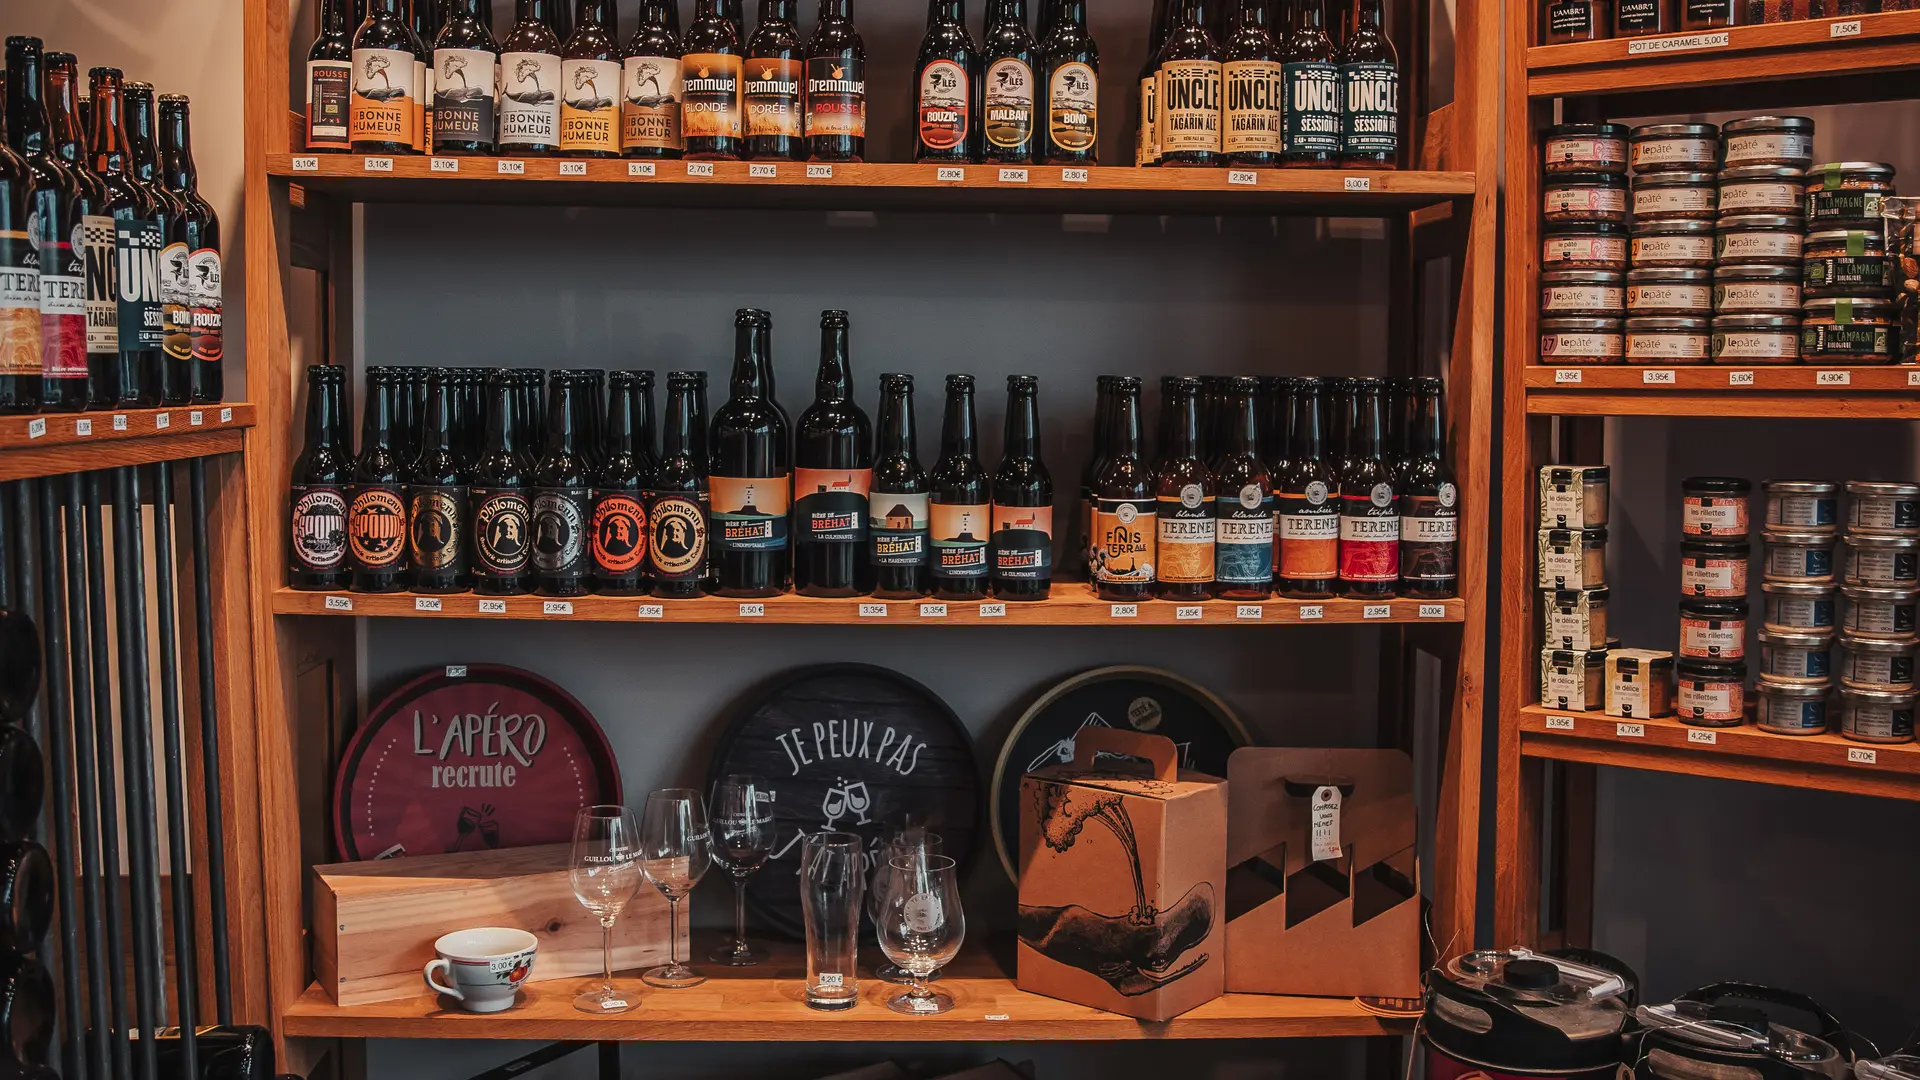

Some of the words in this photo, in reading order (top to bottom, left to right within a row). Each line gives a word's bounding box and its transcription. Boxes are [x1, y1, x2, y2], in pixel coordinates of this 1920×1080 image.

[1630, 42, 1646, 52] POT
[1648, 41, 1660, 50] DE
[1661, 38, 1701, 49] CARAMEL
[313, 69, 348, 79] ROUSSE
[809, 79, 865, 95] Dremmwel
[1167, 79, 1220, 112] UNCLE
[1229, 79, 1280, 112] UNCLE
[686, 102, 728, 113] BLONDE
[750, 102, 786, 115] DORÉE
[815, 102, 858, 114] ROUSSE
[359, 110, 402, 121] BONNE
[438, 110, 480, 121] BONNE
[509, 113, 552, 125] BONNE
[927, 112, 958, 123] ROUZIC
[990, 109, 1028, 123] MALBAN
[1063, 113, 1088, 125] BONO
[353, 121, 401, 133] HUMEUR
[568, 121, 609, 132] BONNE
[630, 117, 672, 128] BONNE
[1170, 118, 1203, 132] TAGARIN
[1231, 118, 1265, 132] TAGARIN
[1301, 119, 1332, 133] SESSION
[1354, 119, 1388, 133] SESSION
[503, 124, 551, 135] HUMEUR
[625, 127, 671, 139] HUMEUR
[563, 131, 609, 142] HUMEUR
[295, 159, 317, 169] 3,10€
[368, 160, 389, 169] 3,10€
[434, 161, 455, 171] 3,10€
[501, 162, 522, 172] 3,10€
[563, 163, 584, 173] 3,10€
[631, 164, 652, 174] 3,10€
[688, 164, 704, 174] 2,70
[751, 166, 767, 176] 2,70
[808, 167, 823, 176] 2,70
[1346, 180, 1360, 189] 3,00
[1731, 373, 1753, 382] 5,60€
[1821, 373, 1844, 382] 4,90€
[296, 494, 346, 514] Philomenn
[352, 493, 401, 514] Philomenn
[480, 500, 530, 523] Philomenn
[596, 500, 645, 524] Philomenn
[651, 502, 701, 525] Philomenn
[1175, 510, 1207, 518] blonde
[1231, 510, 1267, 519] blanche
[1367, 507, 1394, 518] triple
[1106, 526, 1141, 544] FINIS
[419, 600, 440, 609] 3,20€
[482, 601, 504, 611] 2,95€
[546, 603, 567, 612] 2,95€
[981, 605, 1002, 614] 3,35€
[640, 606, 661, 615] 2,95€
[740, 606, 757, 615] 6,50
[863, 606, 884, 615] 3,35€
[923, 606, 944, 615] 3,35€
[414, 701, 547, 767] L'APÉRO
[1691, 732, 1713, 741] 4,25€
[775, 727, 813, 775] JE
[813, 717, 874, 761] PEUX
[875, 726, 927, 775] PAS
[1850, 750, 1874, 760] 6,70€
[431, 763, 516, 788] recrute
[584, 855, 614, 863] GUILLOU
[491, 962, 507, 971] 3,00
[820, 974, 836, 984] 4,20
